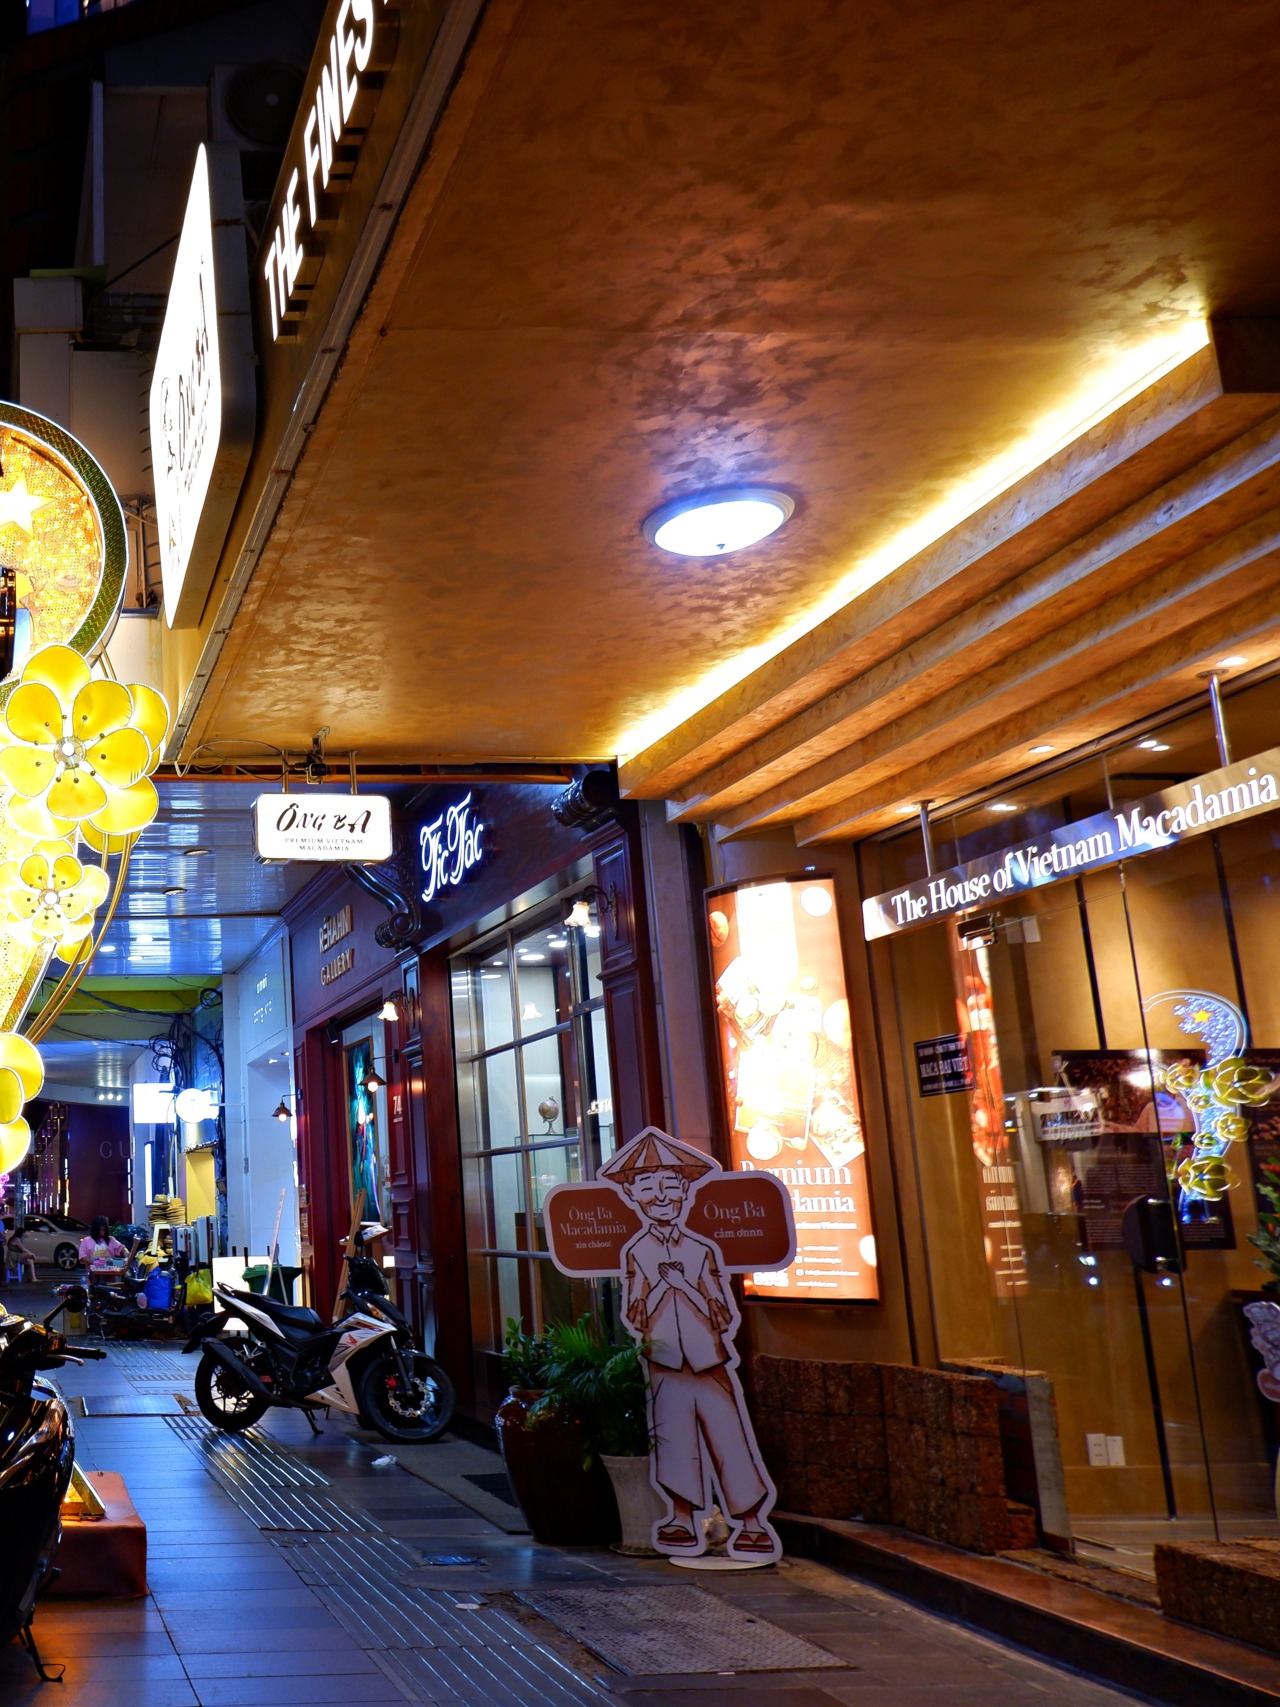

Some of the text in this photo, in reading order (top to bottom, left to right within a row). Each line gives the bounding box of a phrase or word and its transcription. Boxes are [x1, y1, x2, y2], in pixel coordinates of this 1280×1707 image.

[264, 0, 376, 342] THE FINES
[298, 844, 350, 852] MACADAMIA
[891, 767, 1279, 925] The House of Vietnam Macadamia
[321, 948, 353, 986] GALLERY
[740, 1159, 853, 1185] Pmium
[596, 1206, 613, 1220] Ba
[743, 1201, 766, 1218] Ba
[560, 1220, 627, 1236] Macadamia
[575, 1241, 587, 1249] xin
